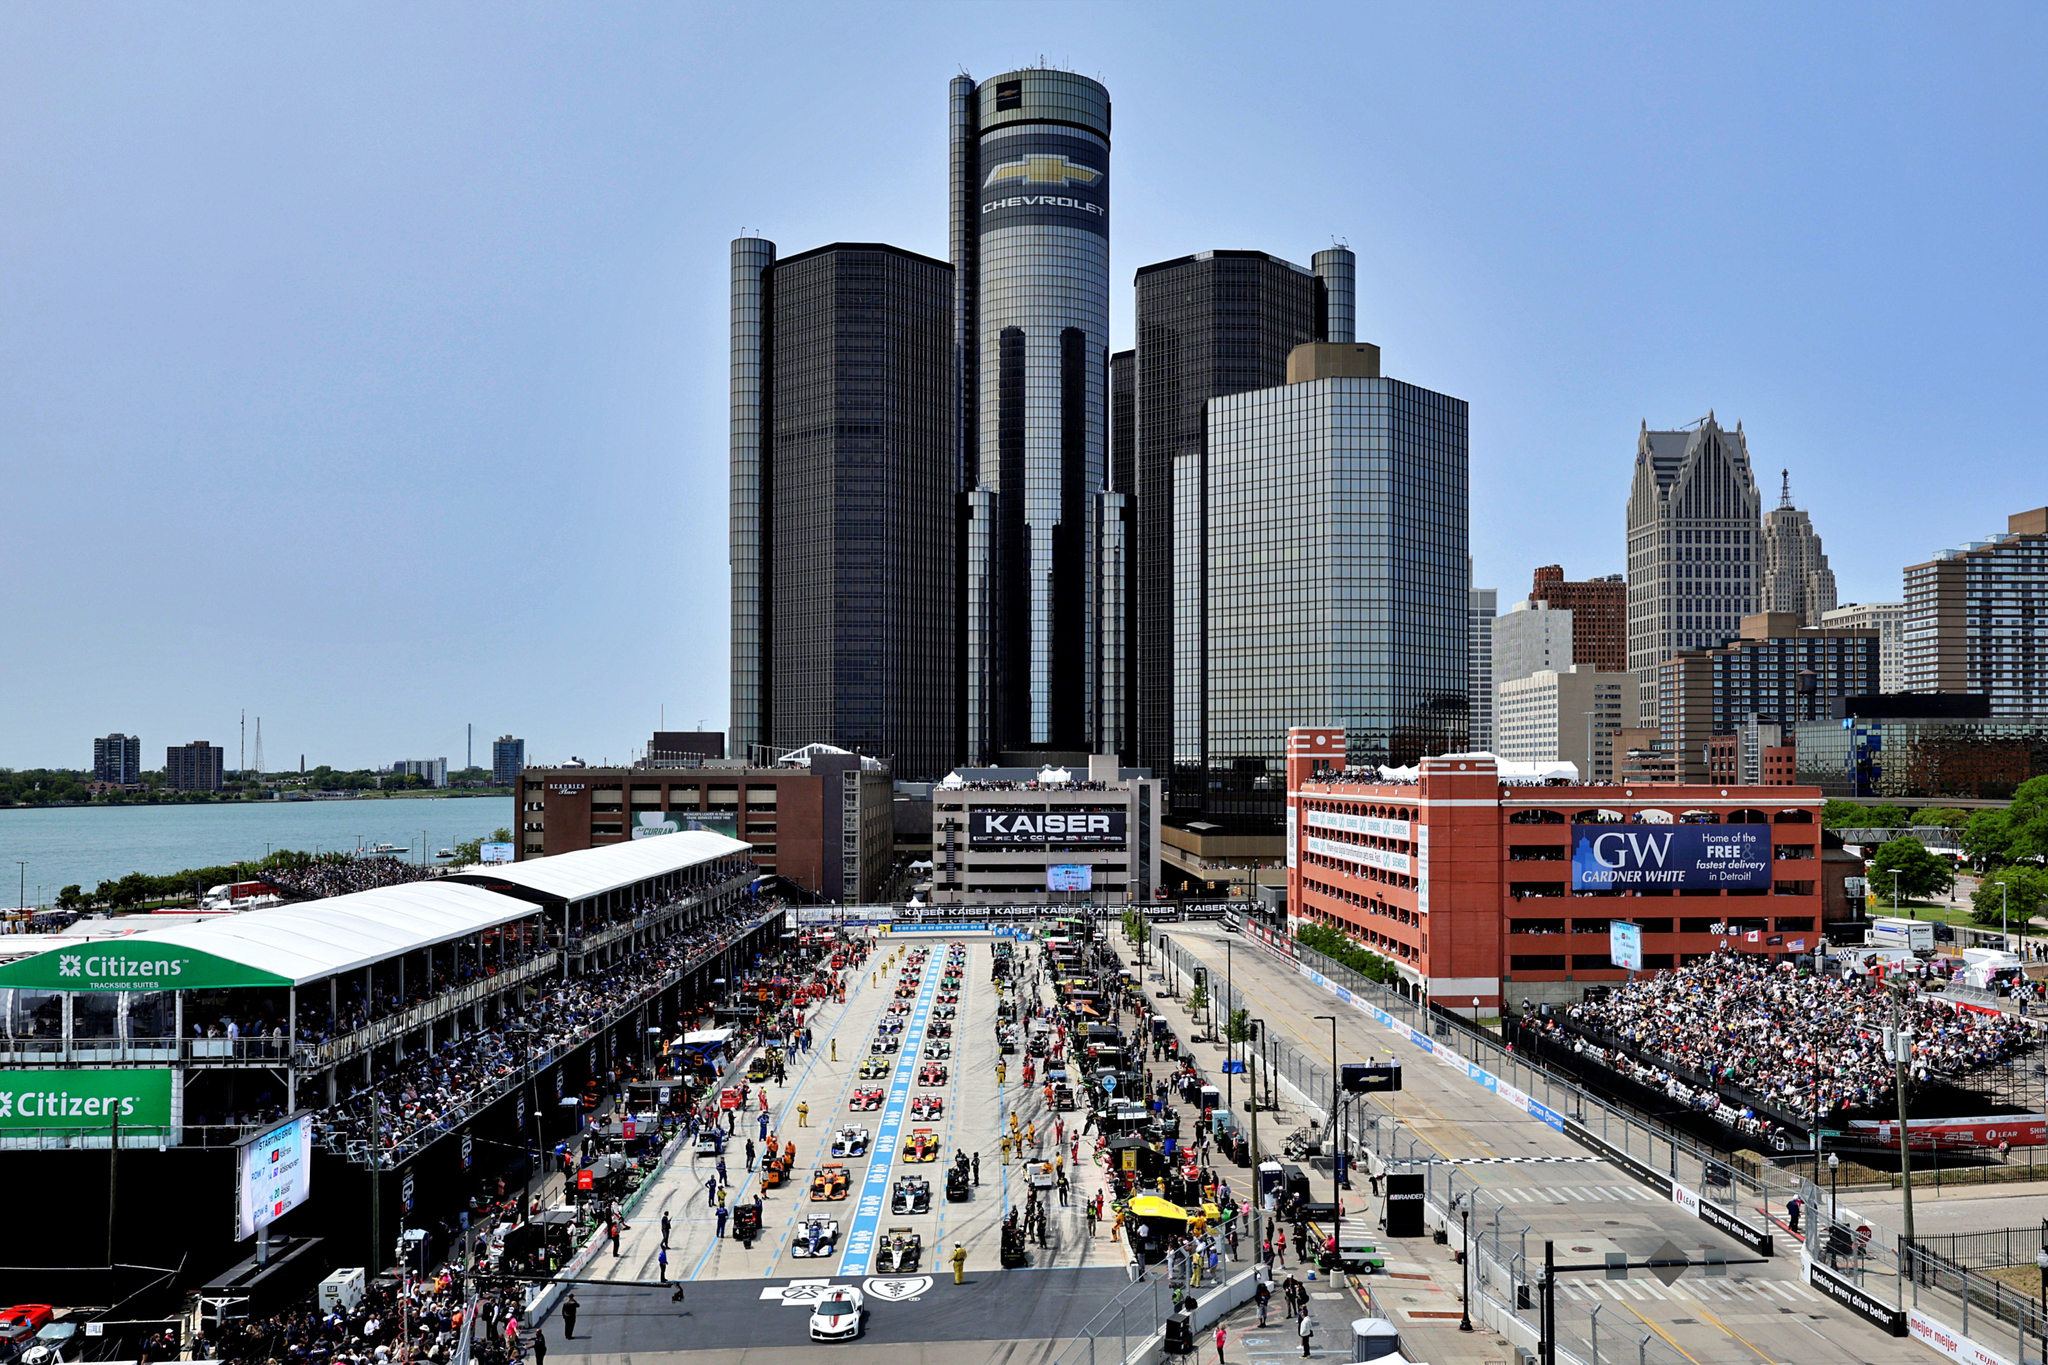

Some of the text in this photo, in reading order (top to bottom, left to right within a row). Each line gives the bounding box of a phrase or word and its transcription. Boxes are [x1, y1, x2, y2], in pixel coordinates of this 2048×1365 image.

[982, 196, 1105, 216] CHEVROLET
[643, 827, 674, 836] CURRAN
[985, 815, 1110, 833] KAISER
[1367, 820, 1380, 832] SIEMENS
[1392, 823, 1407, 836] SIEMENS
[1702, 832, 1756, 843] Home of the
[1593, 832, 1674, 868] GW
[1707, 845, 1741, 858] FREE
[1392, 856, 1407, 869] SIEMENS
[1696, 860, 1766, 871] fastest delivery
[1582, 870, 1685, 883] GARDNER WHITE
[1709, 871, 1751, 881] in Detroit!
[994, 907, 1037, 915] KAISER
[85, 955, 182, 977] Citizens
[694, 1055, 703, 1066] 5
[17, 1091, 134, 1117] Citizens
[259, 1132, 281, 1151] STARTING
[1683, 1196, 1696, 1209] LEAR
[1700, 1204, 1718, 1223] Making
[1718, 1215, 1731, 1230] every
[1731, 1222, 1744, 1236] drive
[1812, 1269, 1834, 1293] Making
[1834, 1285, 1851, 1303] every
[1852, 1294, 1868, 1311] drive
[1910, 1318, 1933, 1338] meijer
[1934, 1331, 1958, 1353] meijer
